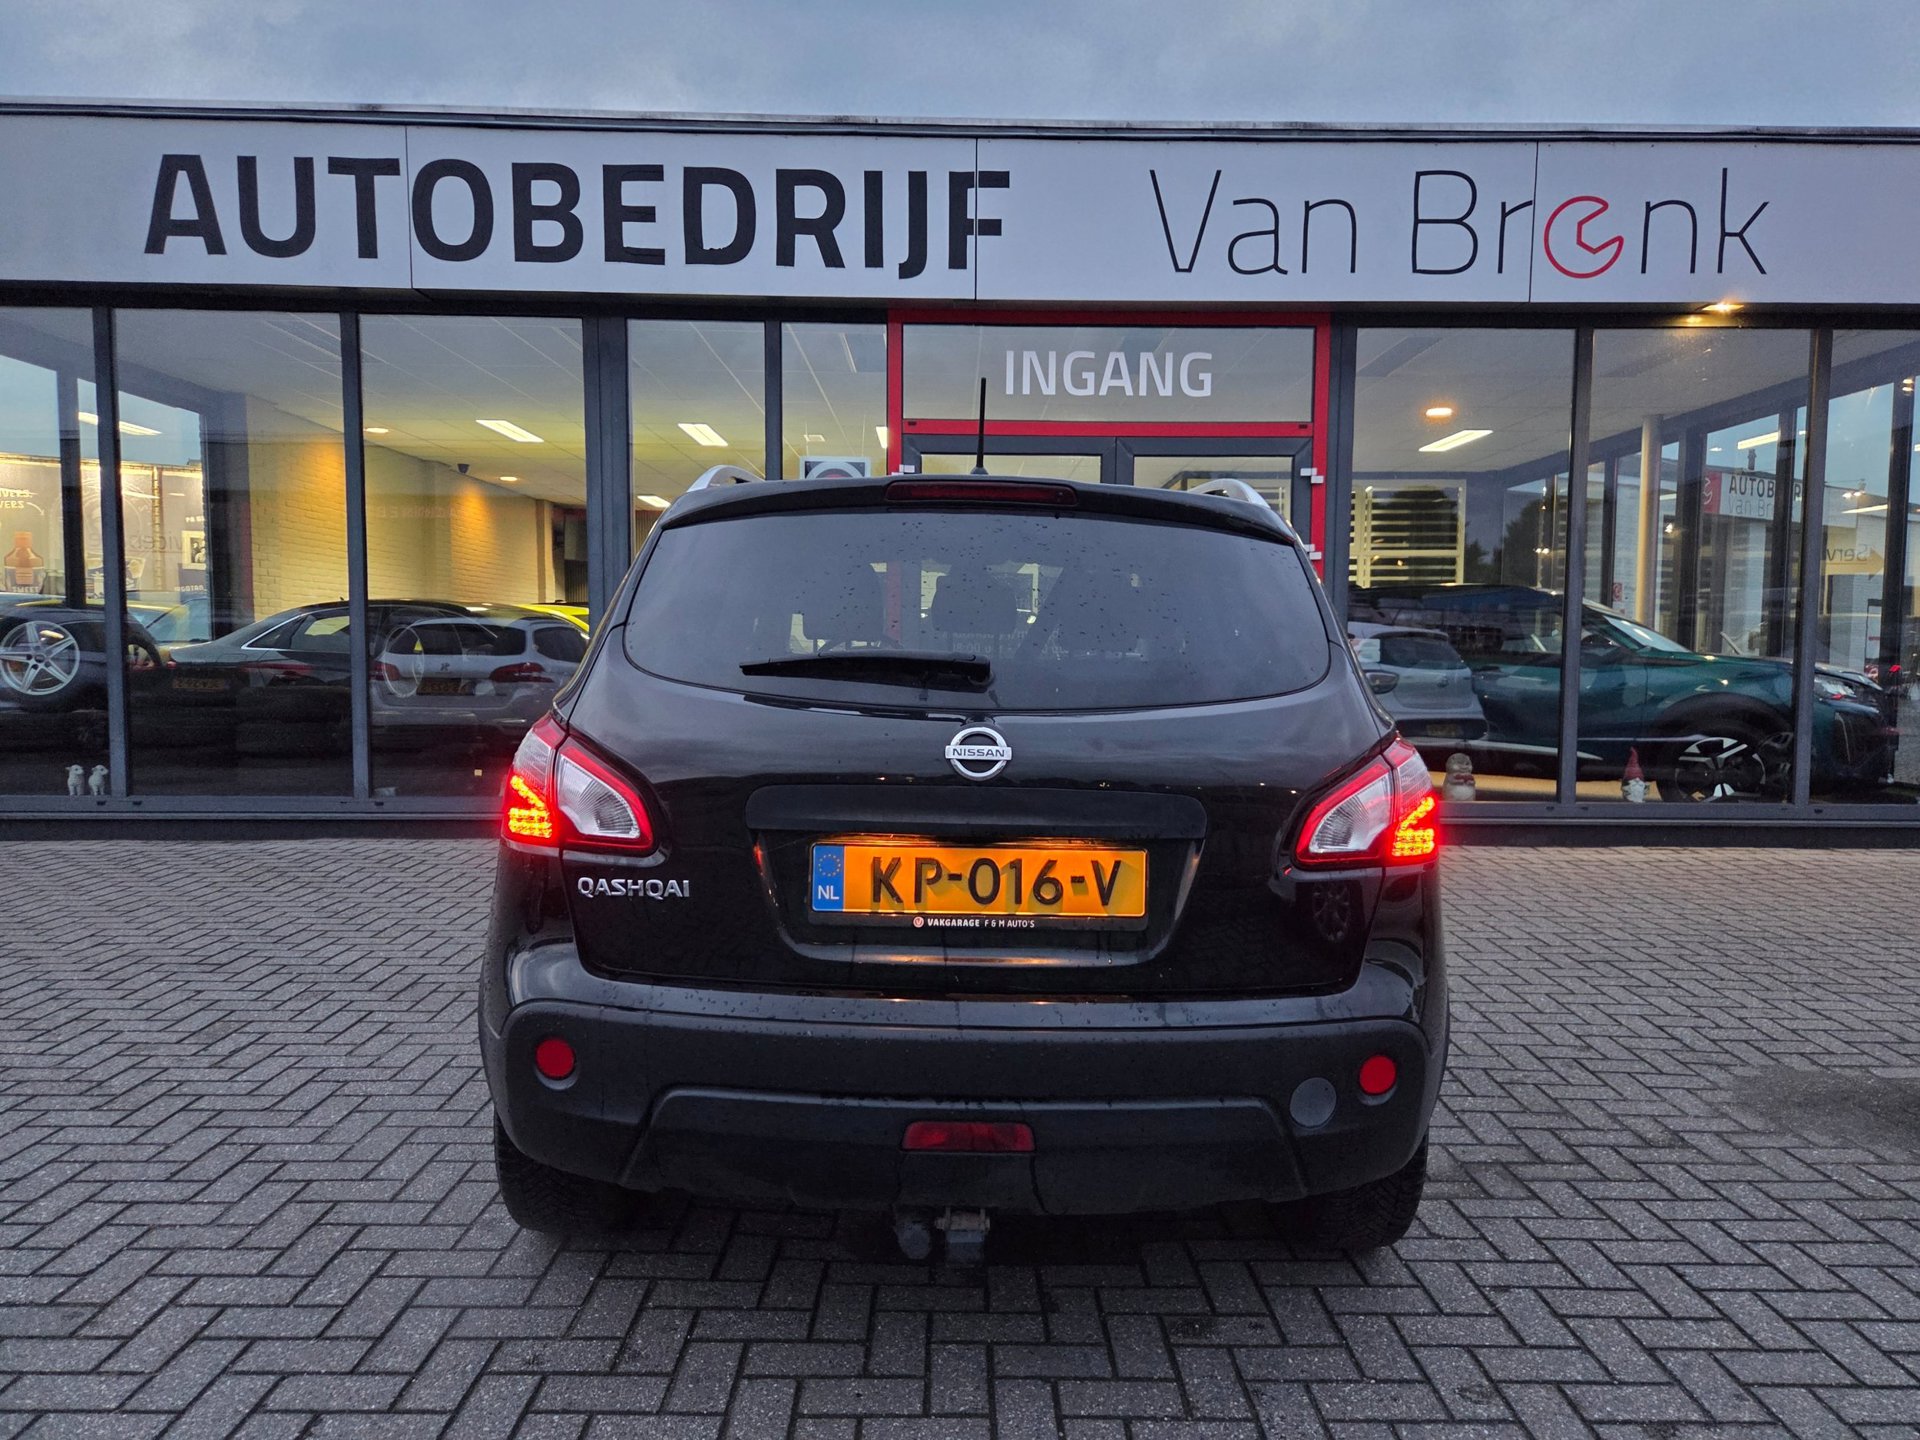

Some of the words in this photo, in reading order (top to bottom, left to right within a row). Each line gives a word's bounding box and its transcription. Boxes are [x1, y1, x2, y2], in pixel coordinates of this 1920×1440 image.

[144, 153, 1010, 280] AUTOBEDRIJF
[1149, 169, 1357, 275] Van
[1005, 350, 1213, 398] INGANG
[952, 748, 1005, 758] NISSAN
[577, 877, 690, 900] QASHQAI
[817, 884, 840, 900] NL
[871, 856, 1122, 906] KP-016-V
[927, 918, 980, 927] VAKGARAGE
[998, 919, 1005, 927] M
[1007, 919, 1035, 928] AUTO'S
